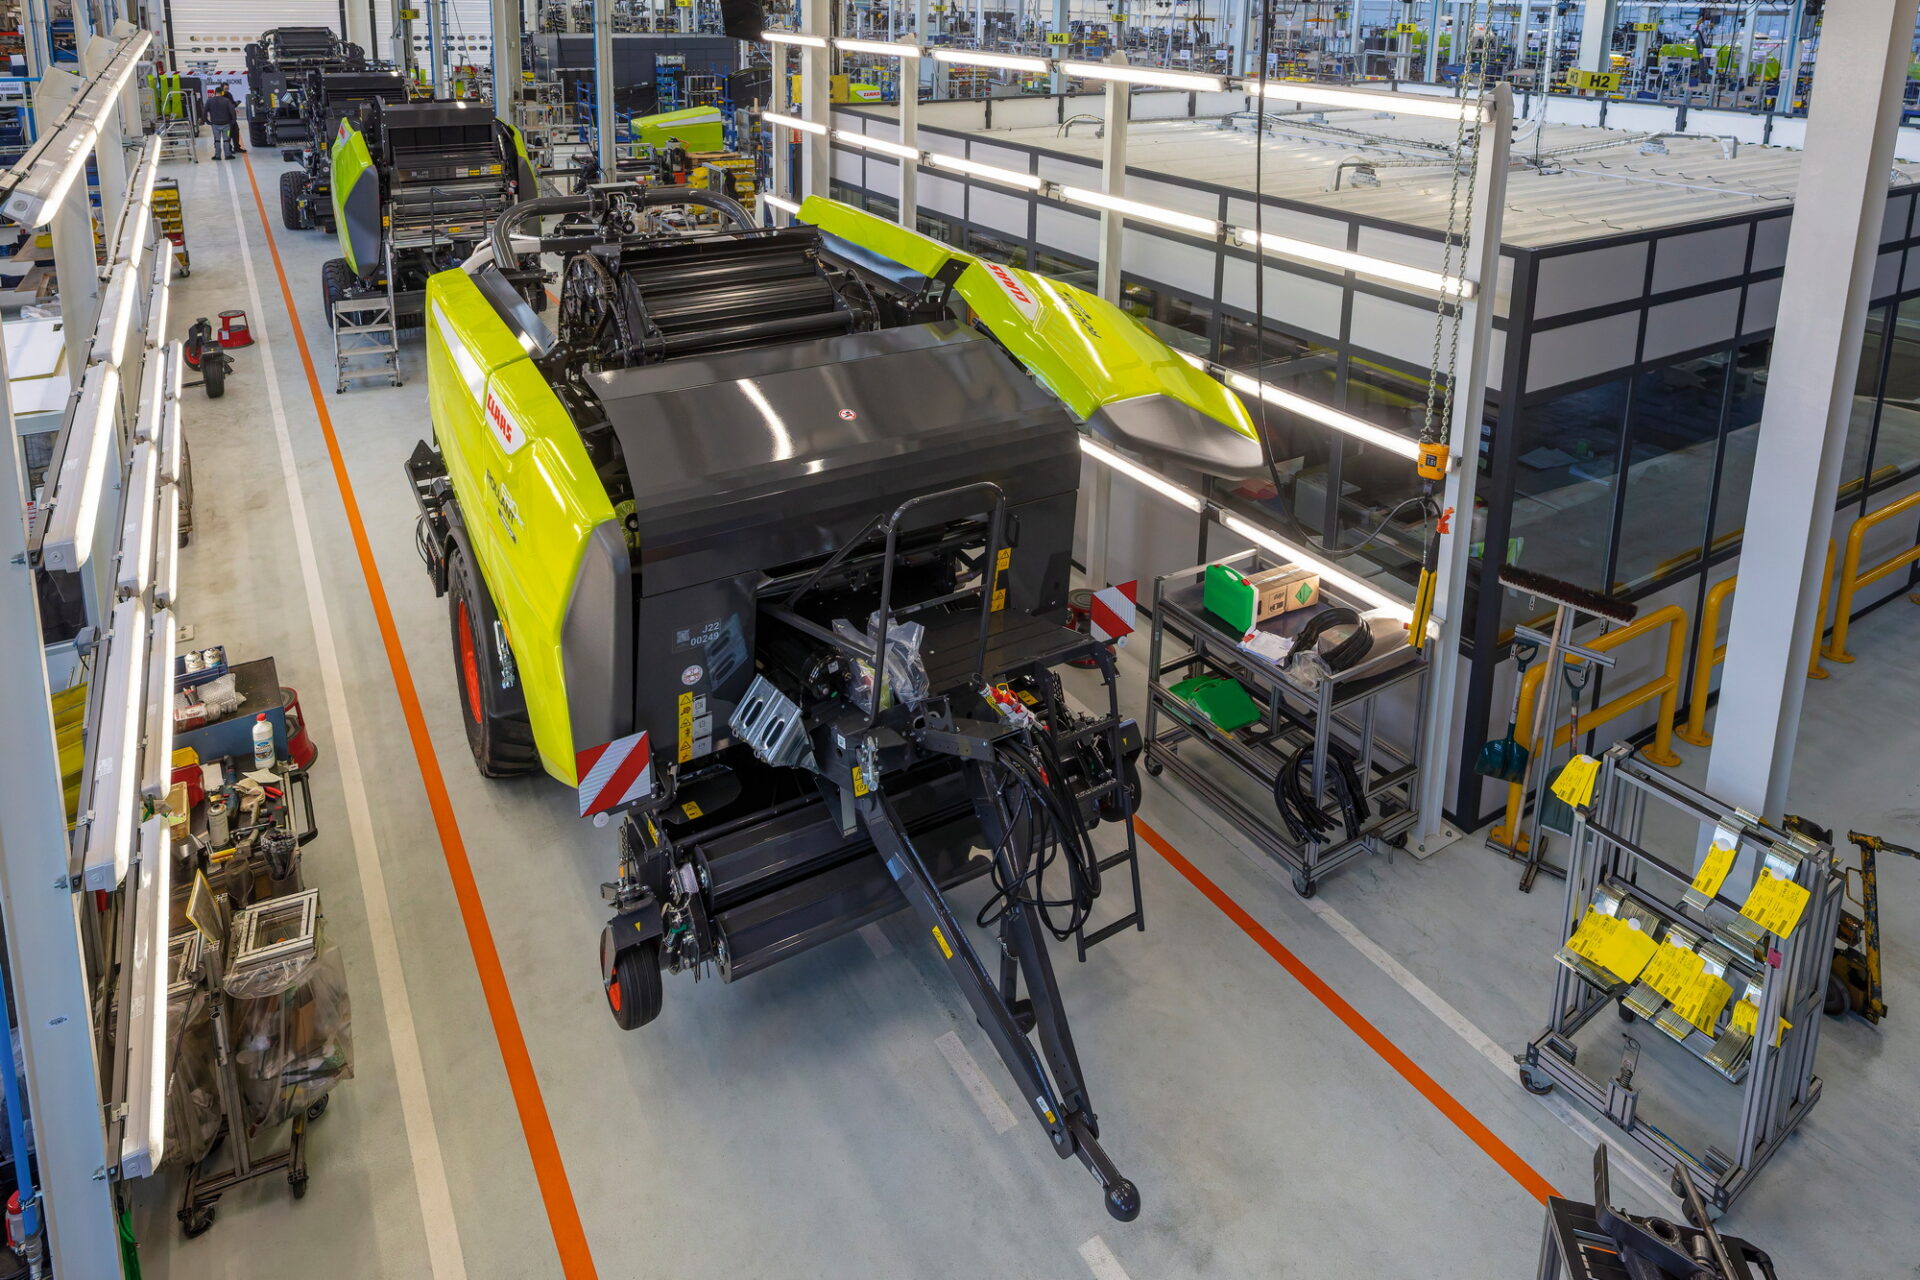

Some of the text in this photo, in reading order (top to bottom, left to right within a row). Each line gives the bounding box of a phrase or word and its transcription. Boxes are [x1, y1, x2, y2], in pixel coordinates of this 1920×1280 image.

[1052, 34, 1064, 43] H4
[1570, 71, 1579, 84] H3
[1589, 75, 1611, 88] H2
[986, 263, 1032, 305] CLAAS
[486, 393, 513, 444] CLAAS
[702, 621, 720, 634] J22
[690, 632, 719, 646] 00249
